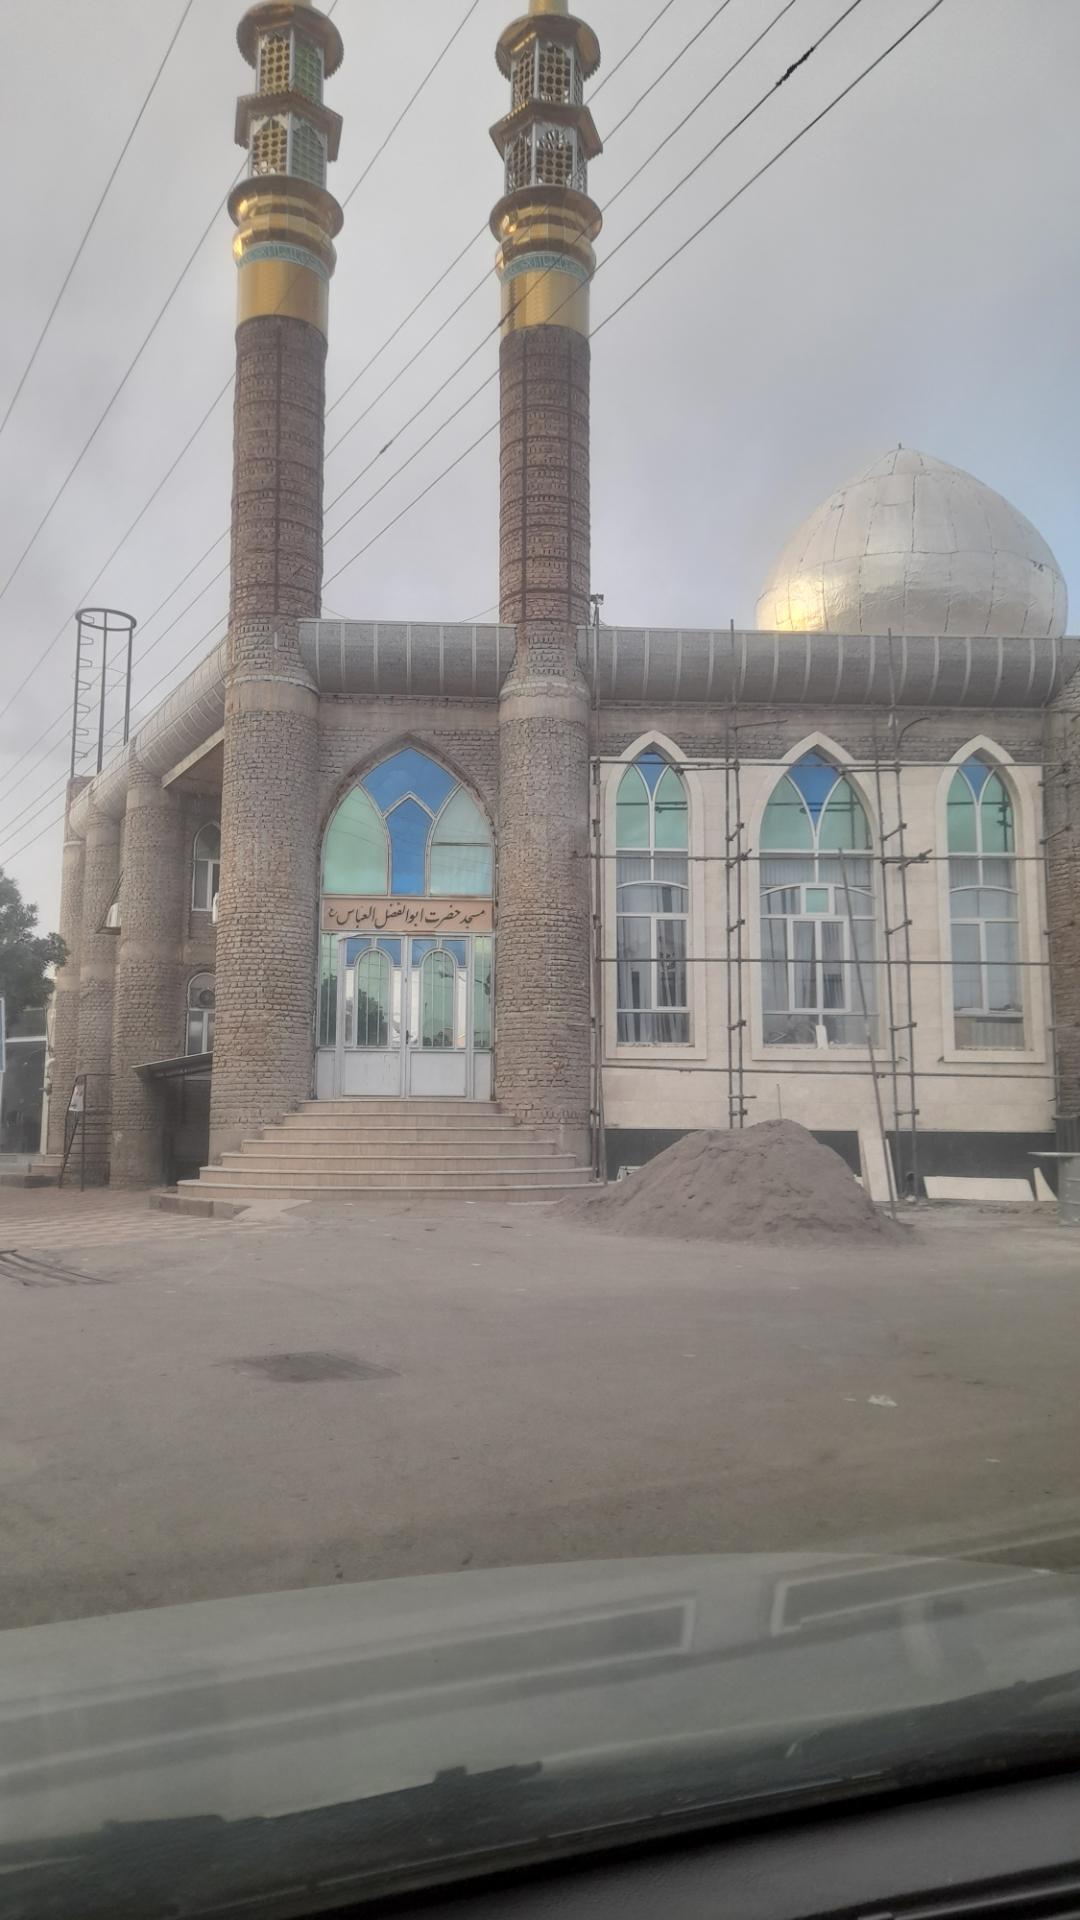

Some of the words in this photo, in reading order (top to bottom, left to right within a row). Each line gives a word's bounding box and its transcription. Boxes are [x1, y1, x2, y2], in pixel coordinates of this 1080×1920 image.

[336, 907, 376, 928] العباس
[425, 904, 461, 928] حضرت
[460, 909, 485, 929] مسجد
